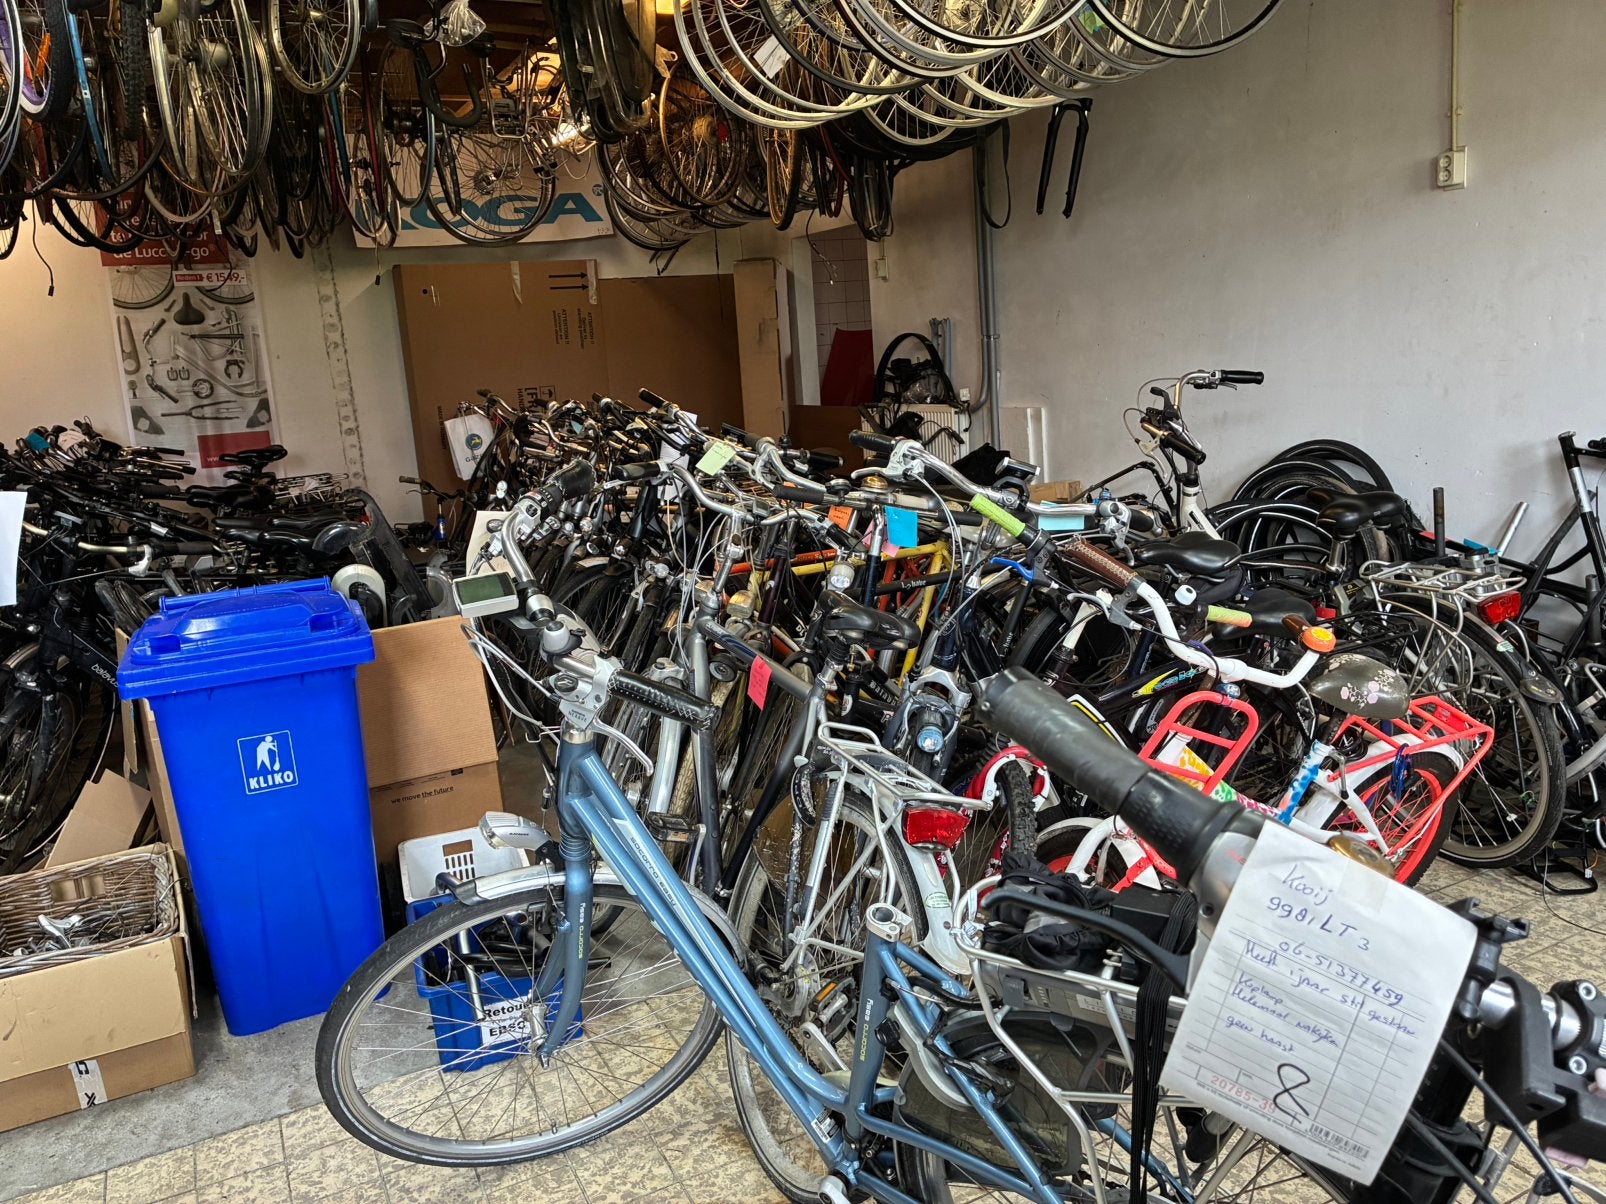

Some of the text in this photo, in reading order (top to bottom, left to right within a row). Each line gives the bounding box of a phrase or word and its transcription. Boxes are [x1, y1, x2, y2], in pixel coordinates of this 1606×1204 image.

[249, 771, 294, 790] KLIKO
[402, 794, 421, 802] move
[421, 790, 433, 799] the
[433, 786, 454, 796] future
[629, 836, 659, 879] socorro
[860, 998, 874, 1061] socorro easy
